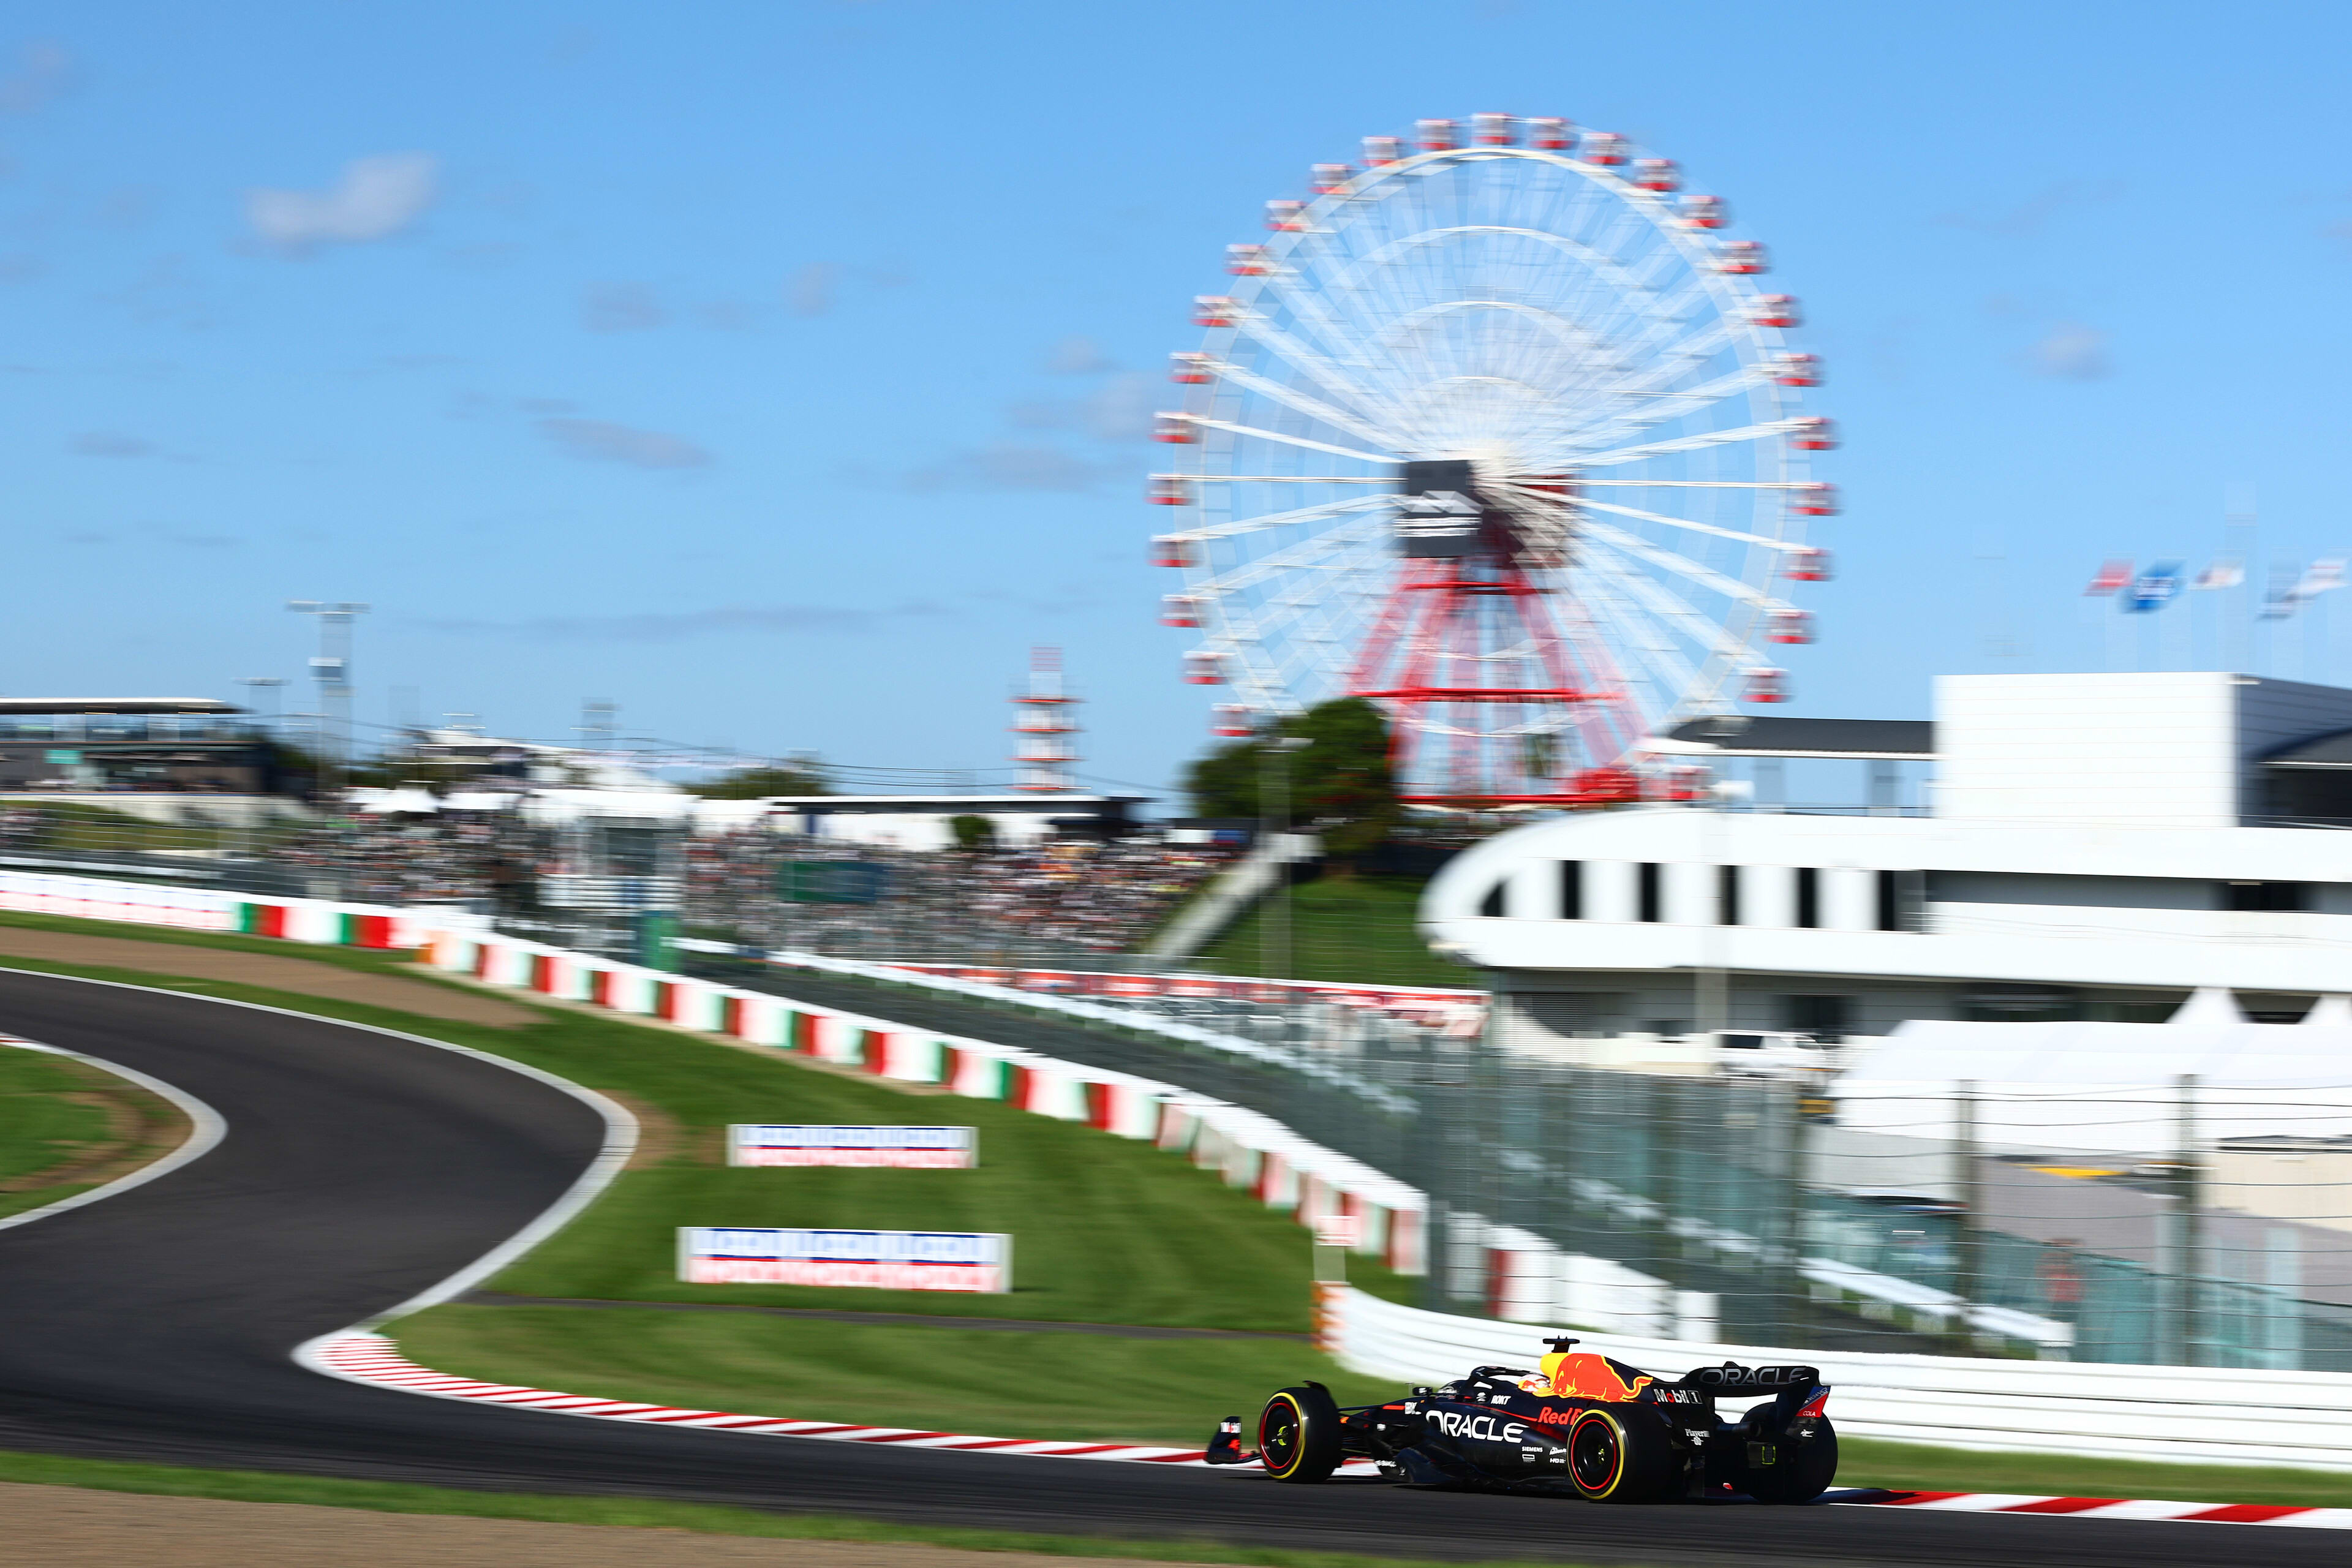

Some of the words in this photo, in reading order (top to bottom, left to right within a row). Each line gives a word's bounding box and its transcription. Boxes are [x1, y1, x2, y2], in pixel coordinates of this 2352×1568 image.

[1700, 1368, 1806, 1385] ORACLE
[1654, 1389, 1690, 1403] Mobil
[1425, 1410, 1529, 1444] ORACLE
